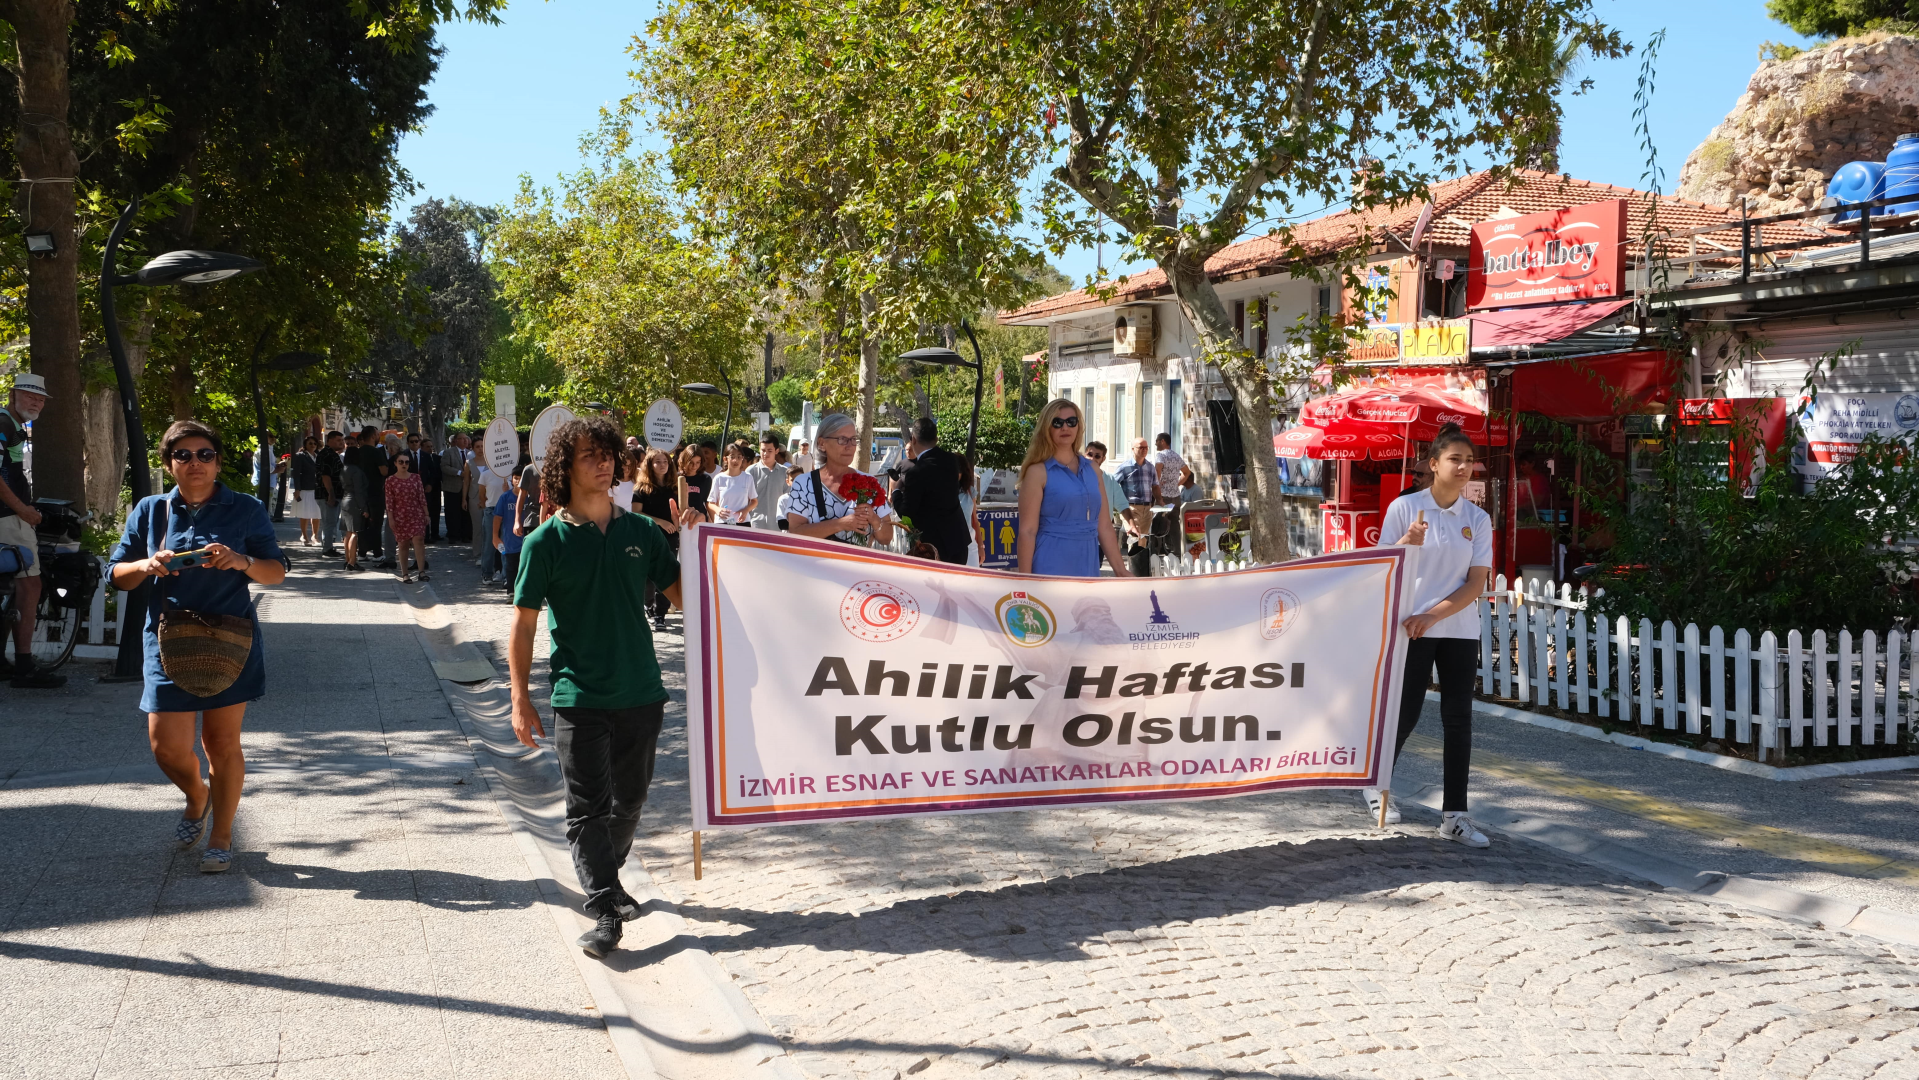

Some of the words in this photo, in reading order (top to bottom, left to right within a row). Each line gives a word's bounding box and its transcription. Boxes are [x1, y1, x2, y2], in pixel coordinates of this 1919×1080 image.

[1482, 239, 1599, 275] battalbey
[1504, 290, 1523, 299] lezzet
[1524, 287, 1557, 297] anlatılmaz
[1847, 398, 1866, 407] FOÇA
[1356, 408, 1381, 417] Gerçek
[1853, 408, 1879, 417] MİDİLLİ
[1436, 411, 1467, 426] Coca-Cola
[1866, 421, 1892, 429] YELKEN
[1812, 444, 1838, 453] AMATÖR
[1128, 631, 1200, 642] BÜYÜKŞEHİR
[1132, 641, 1196, 650] BELEDİYESİ
[804, 656, 1040, 700] Ahilik
[1063, 661, 1305, 699] Haftası
[834, 714, 1035, 756] Kutlu
[1062, 711, 1282, 748] Olsun.
[739, 773, 817, 798] İZMİR
[825, 771, 914, 793] ESNAF
[921, 770, 956, 788] VE
[964, 760, 1153, 786] SANATKARLAR
[1160, 757, 1271, 776] ODALARI
[1276, 746, 1357, 769] BİRLİĞİ
